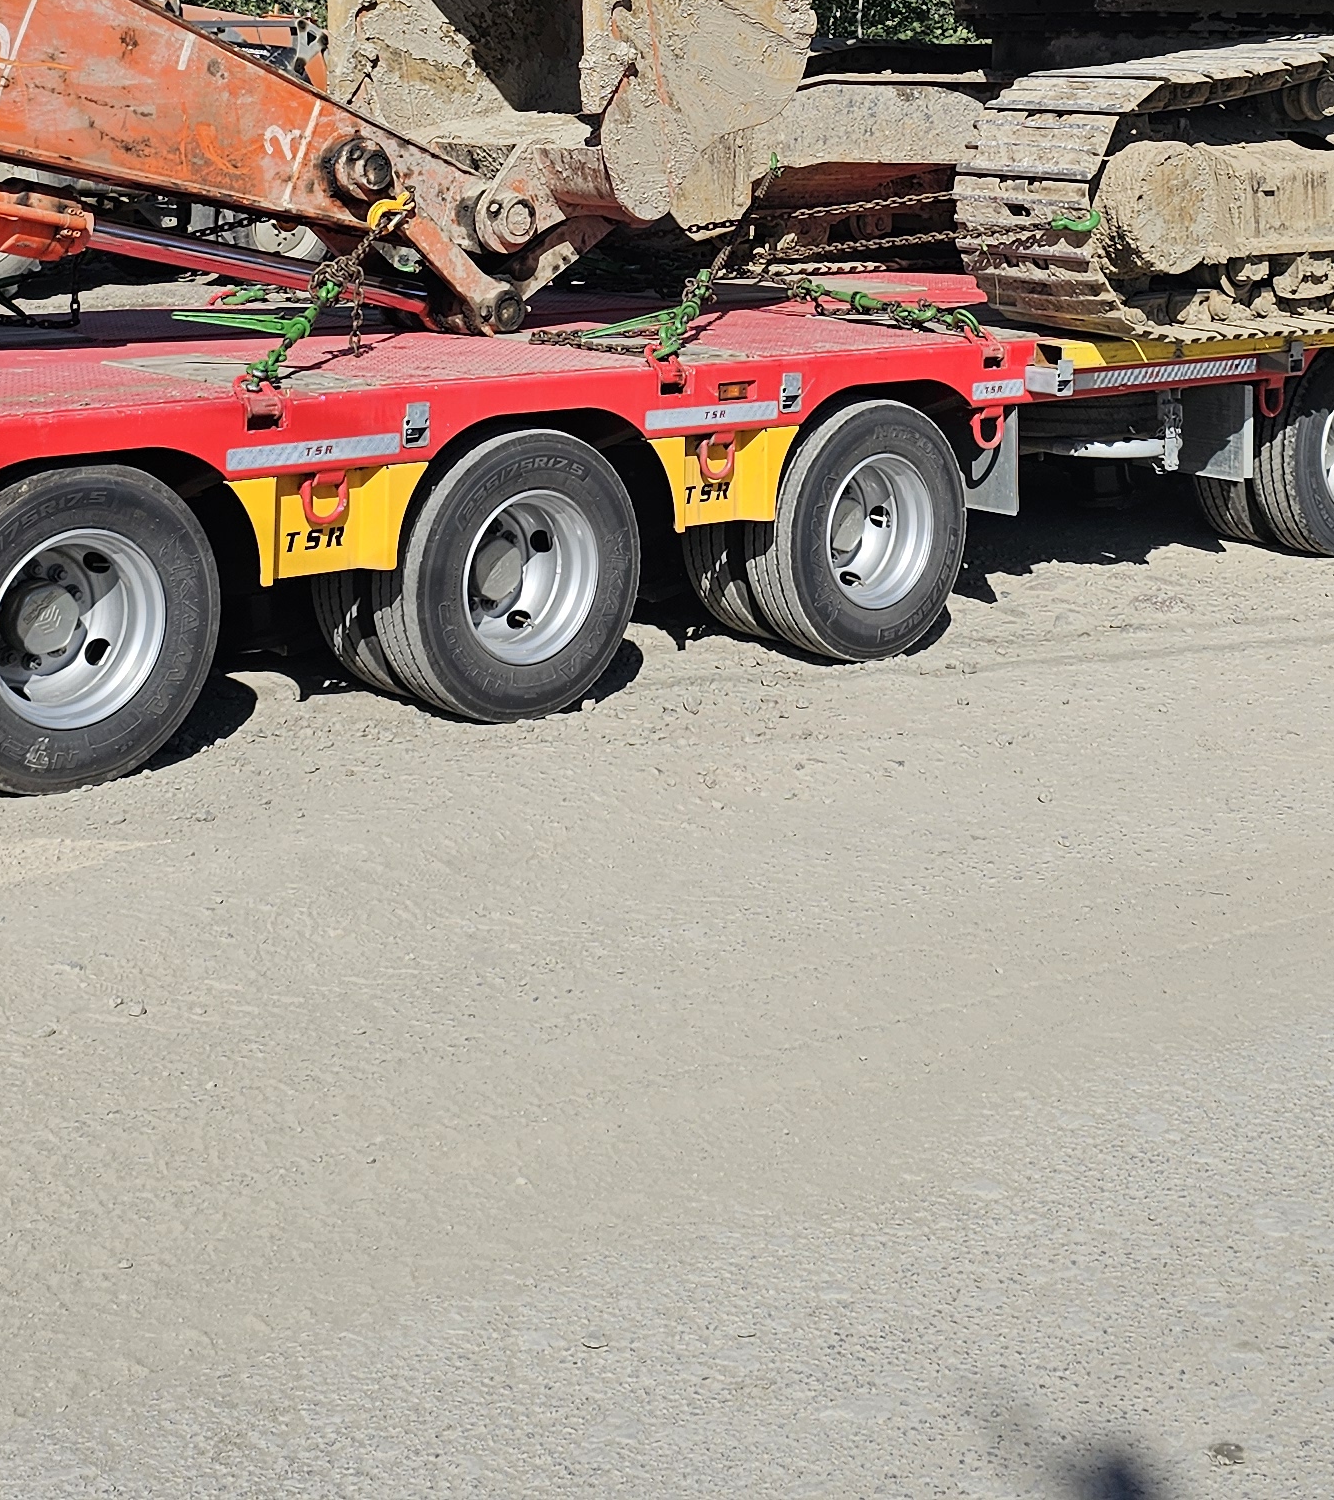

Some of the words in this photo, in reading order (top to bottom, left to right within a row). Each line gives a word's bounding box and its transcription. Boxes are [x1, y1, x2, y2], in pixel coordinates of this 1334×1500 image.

[984, 385, 1003, 394] TSR
[704, 410, 726, 420] TSR
[305, 445, 334, 456] TSR
[685, 481, 731, 505] TSR
[285, 525, 345, 553] TSR
